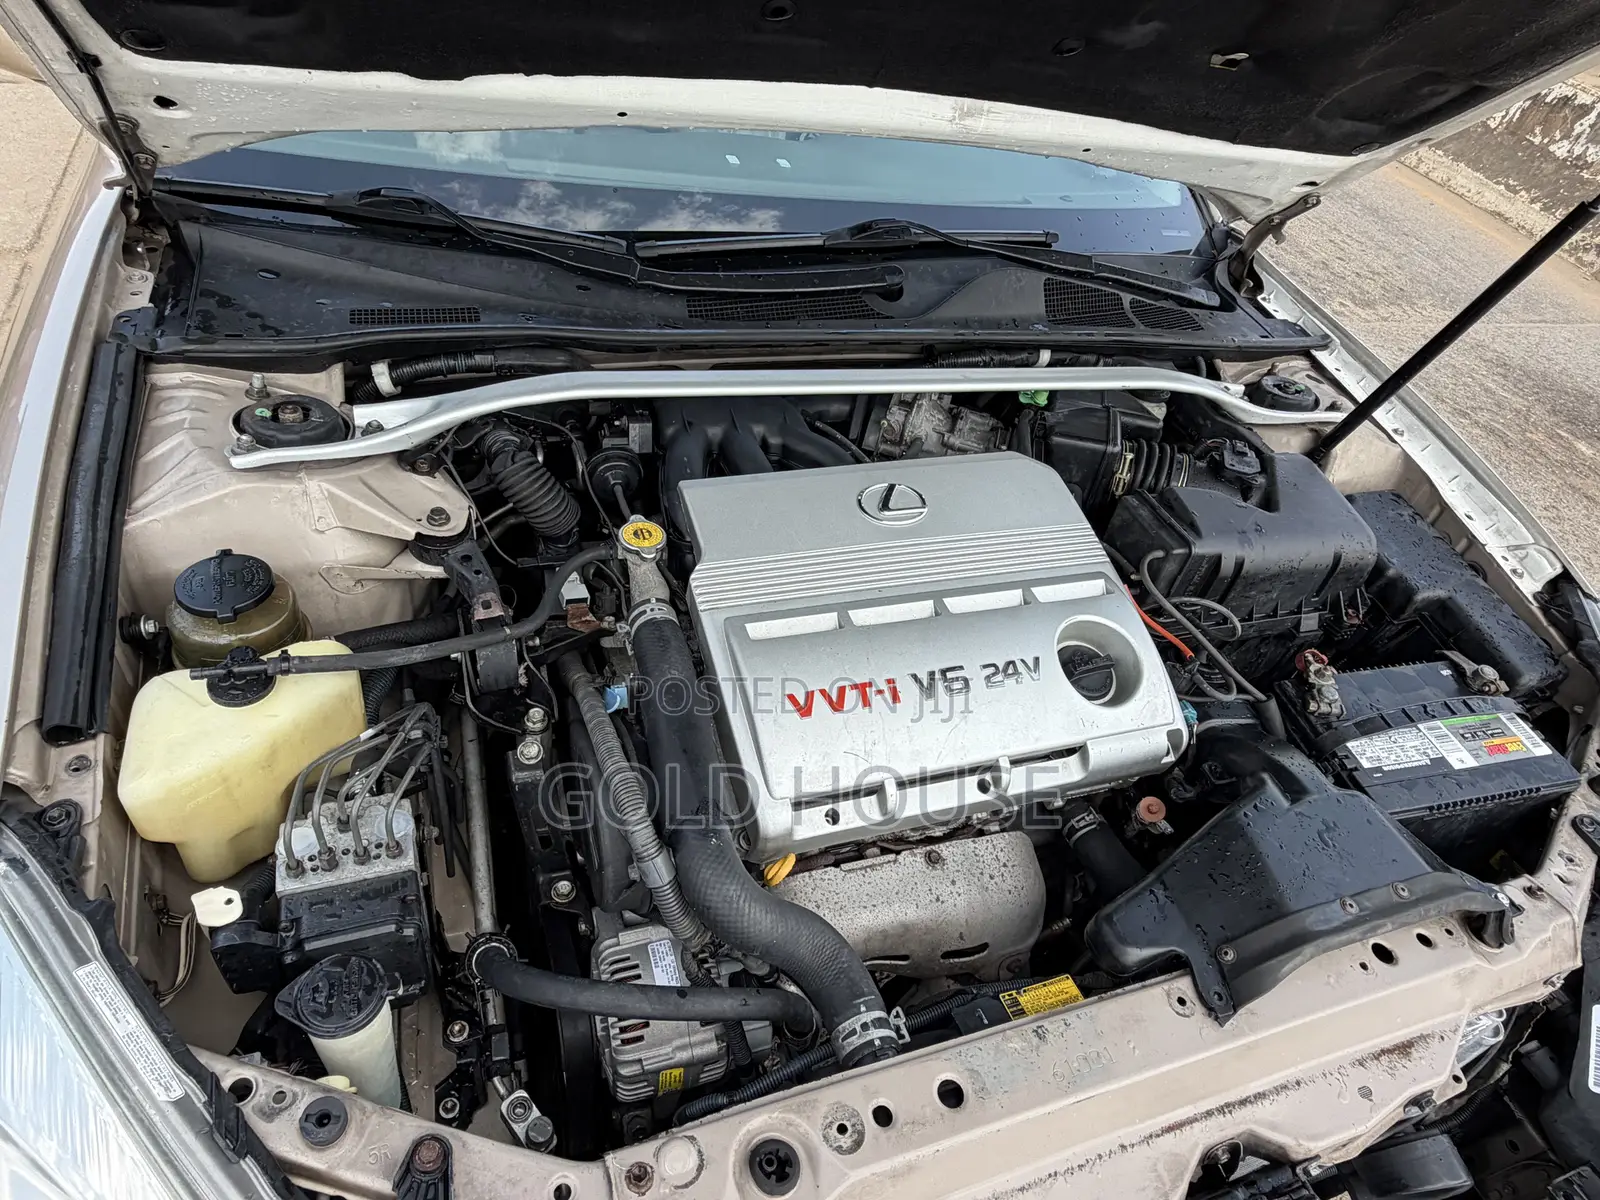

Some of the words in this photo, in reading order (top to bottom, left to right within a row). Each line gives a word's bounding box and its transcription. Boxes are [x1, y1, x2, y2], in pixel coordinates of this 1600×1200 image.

[786, 678, 901, 720] VVT-i
[906, 665, 972, 701] V6
[979, 656, 1041, 690] 24V
